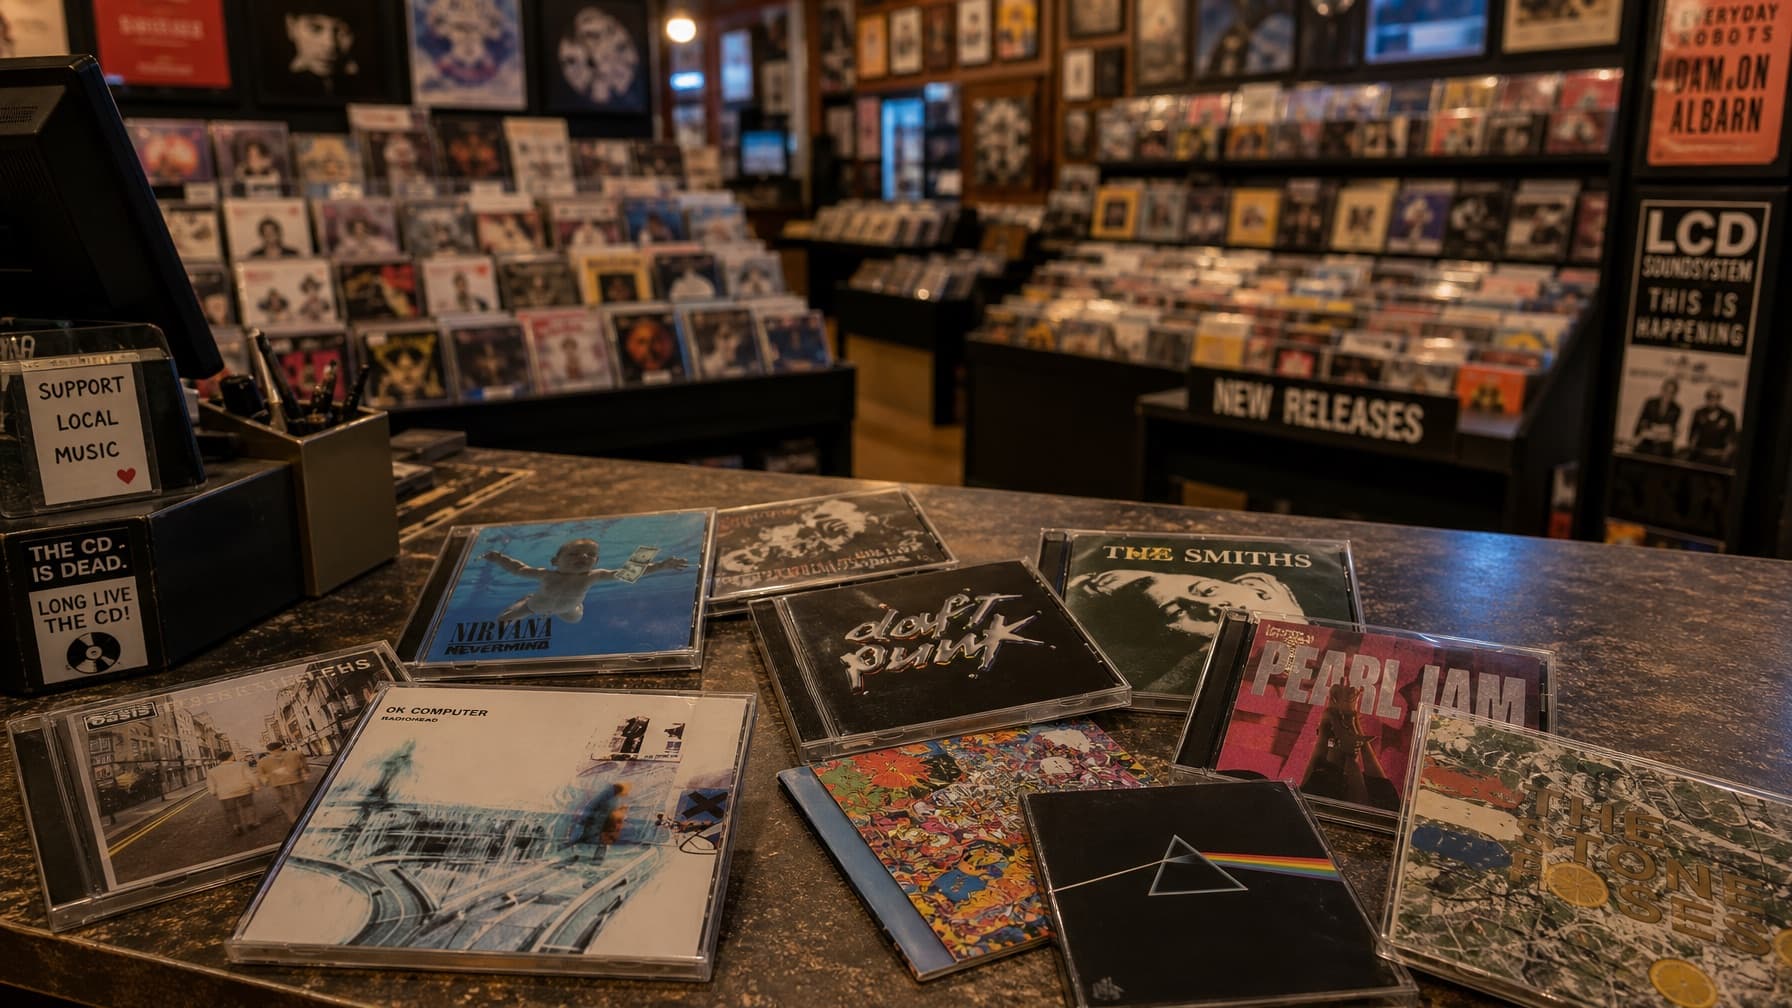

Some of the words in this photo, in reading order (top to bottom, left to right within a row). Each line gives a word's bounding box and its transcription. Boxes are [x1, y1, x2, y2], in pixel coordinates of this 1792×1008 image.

[1669, 96, 1763, 134] ALBARN
[1646, 209, 1758, 257] LCD
[1642, 255, 1754, 283] SOUNDSYSTEM
[1648, 286, 1701, 315] THIS
[1713, 292, 1738, 318] IS
[1635, 316, 1745, 347] HAPPENING
[38, 375, 125, 400] SUPPORT
[56, 410, 119, 431] LOCAL
[1213, 377, 1274, 421] NEW
[1283, 386, 1424, 444] RELEASES
[54, 441, 120, 464] MUSIC
[28, 541, 74, 562] THE
[1103, 545, 1174, 562] THE
[1184, 548, 1313, 569] SMITHS
[32, 566, 54, 583] IS
[61, 555, 128, 578] DEAD.
[38, 594, 87, 616] LONG
[93, 586, 133, 607] LIVE
[43, 614, 87, 634] THE
[94, 606, 130, 625] CD!
[451, 618, 552, 643] NIRVANA
[445, 640, 549, 655] NEVERMIND
[1251, 639, 1402, 720] PEARL
[1411, 663, 1527, 728] JAM
[386, 706, 406, 714] OK
[411, 707, 489, 717] COMPUTER
[1520, 783, 1665, 848] THE
[1514, 816, 1768, 913] STONE
